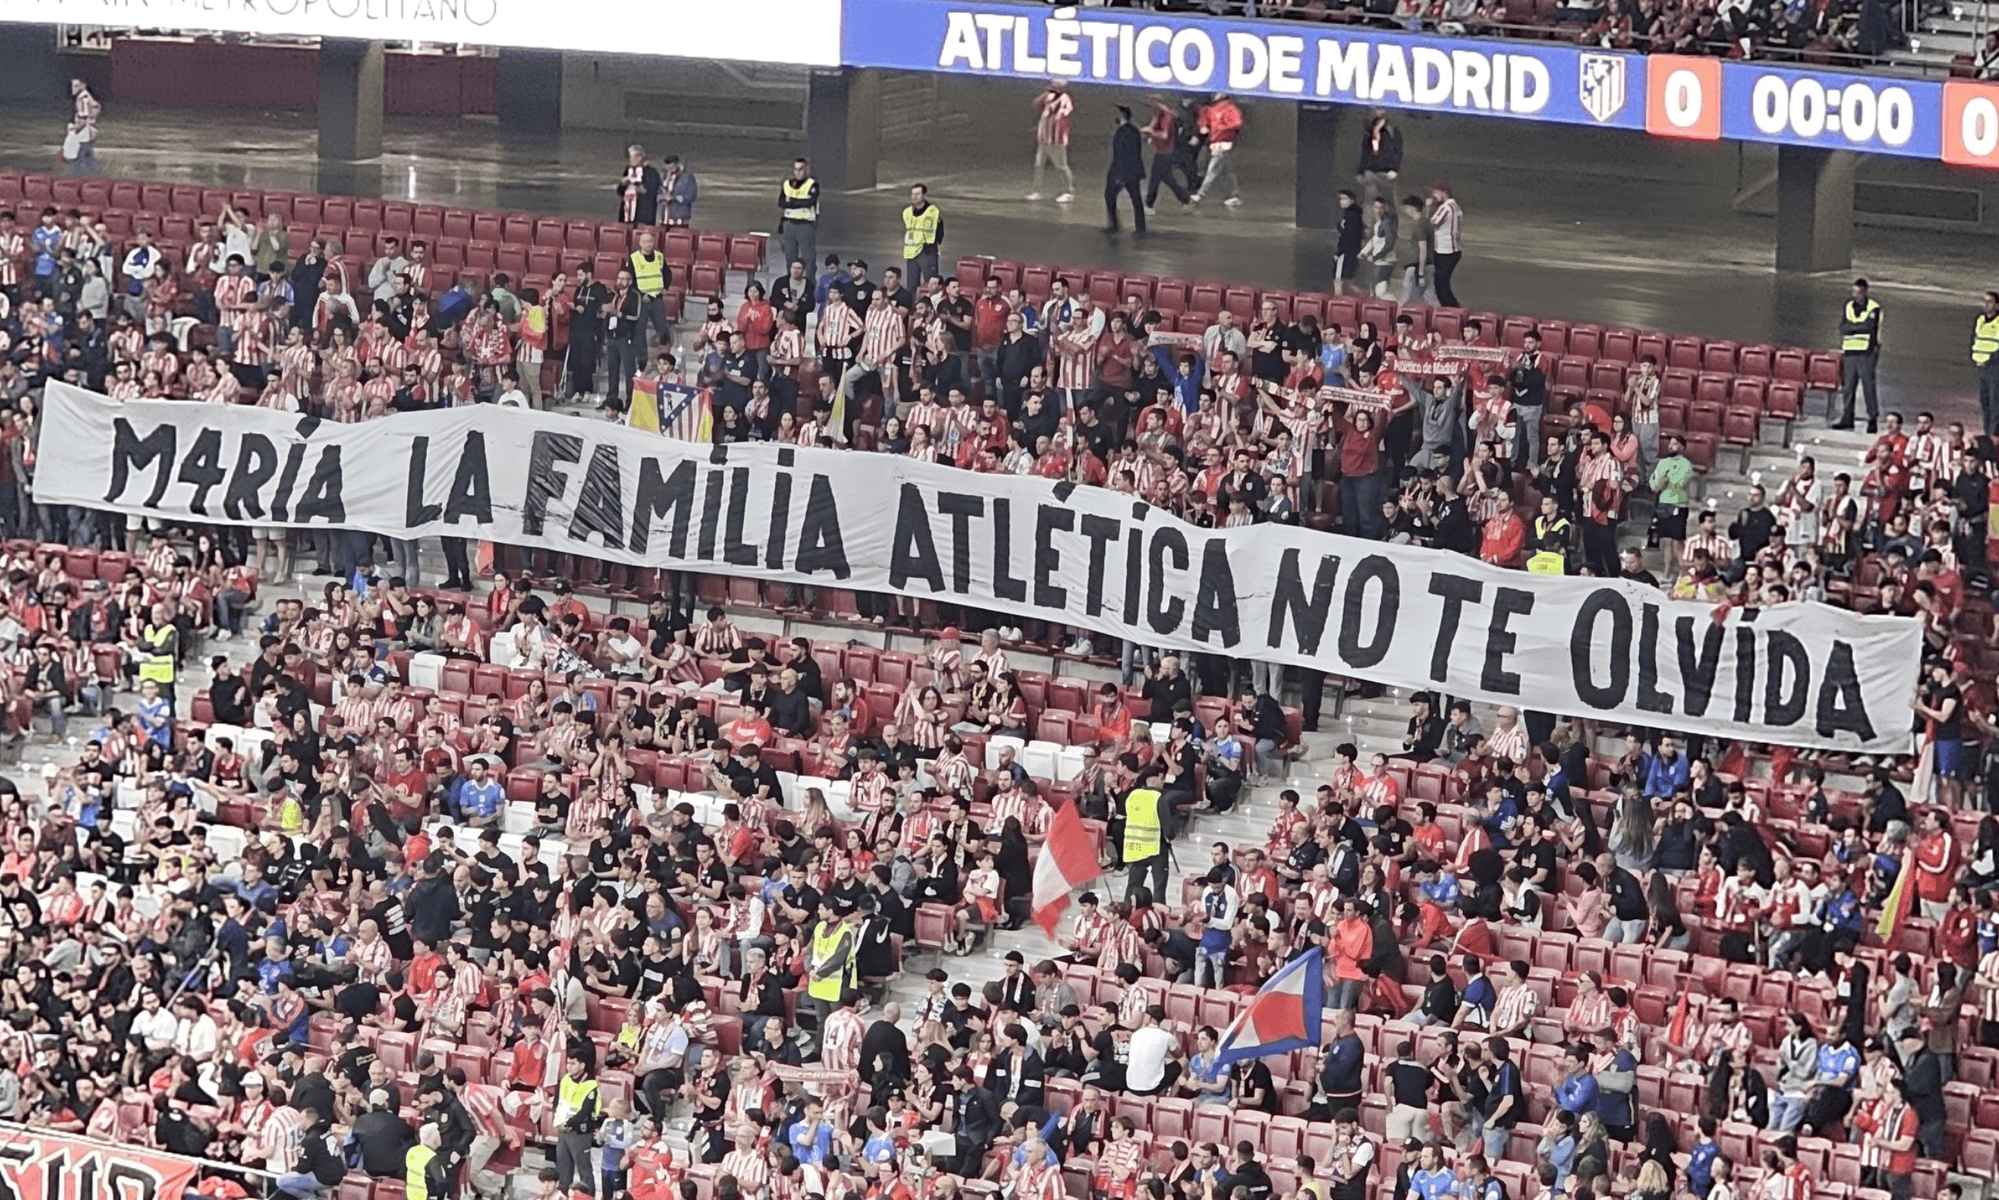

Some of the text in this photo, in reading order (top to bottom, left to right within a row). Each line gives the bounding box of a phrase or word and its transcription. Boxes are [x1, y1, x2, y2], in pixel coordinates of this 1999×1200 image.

[939, 6, 1550, 113] ATLÉTICO DE MADRID
[1664, 69, 1702, 127] 0
[1752, 75, 1914, 145] 00:00
[1961, 97, 1999, 156] 0
[406, 430, 494, 528] LA
[1267, 549, 1400, 669] NO
[1428, 571, 1535, 696] TE
